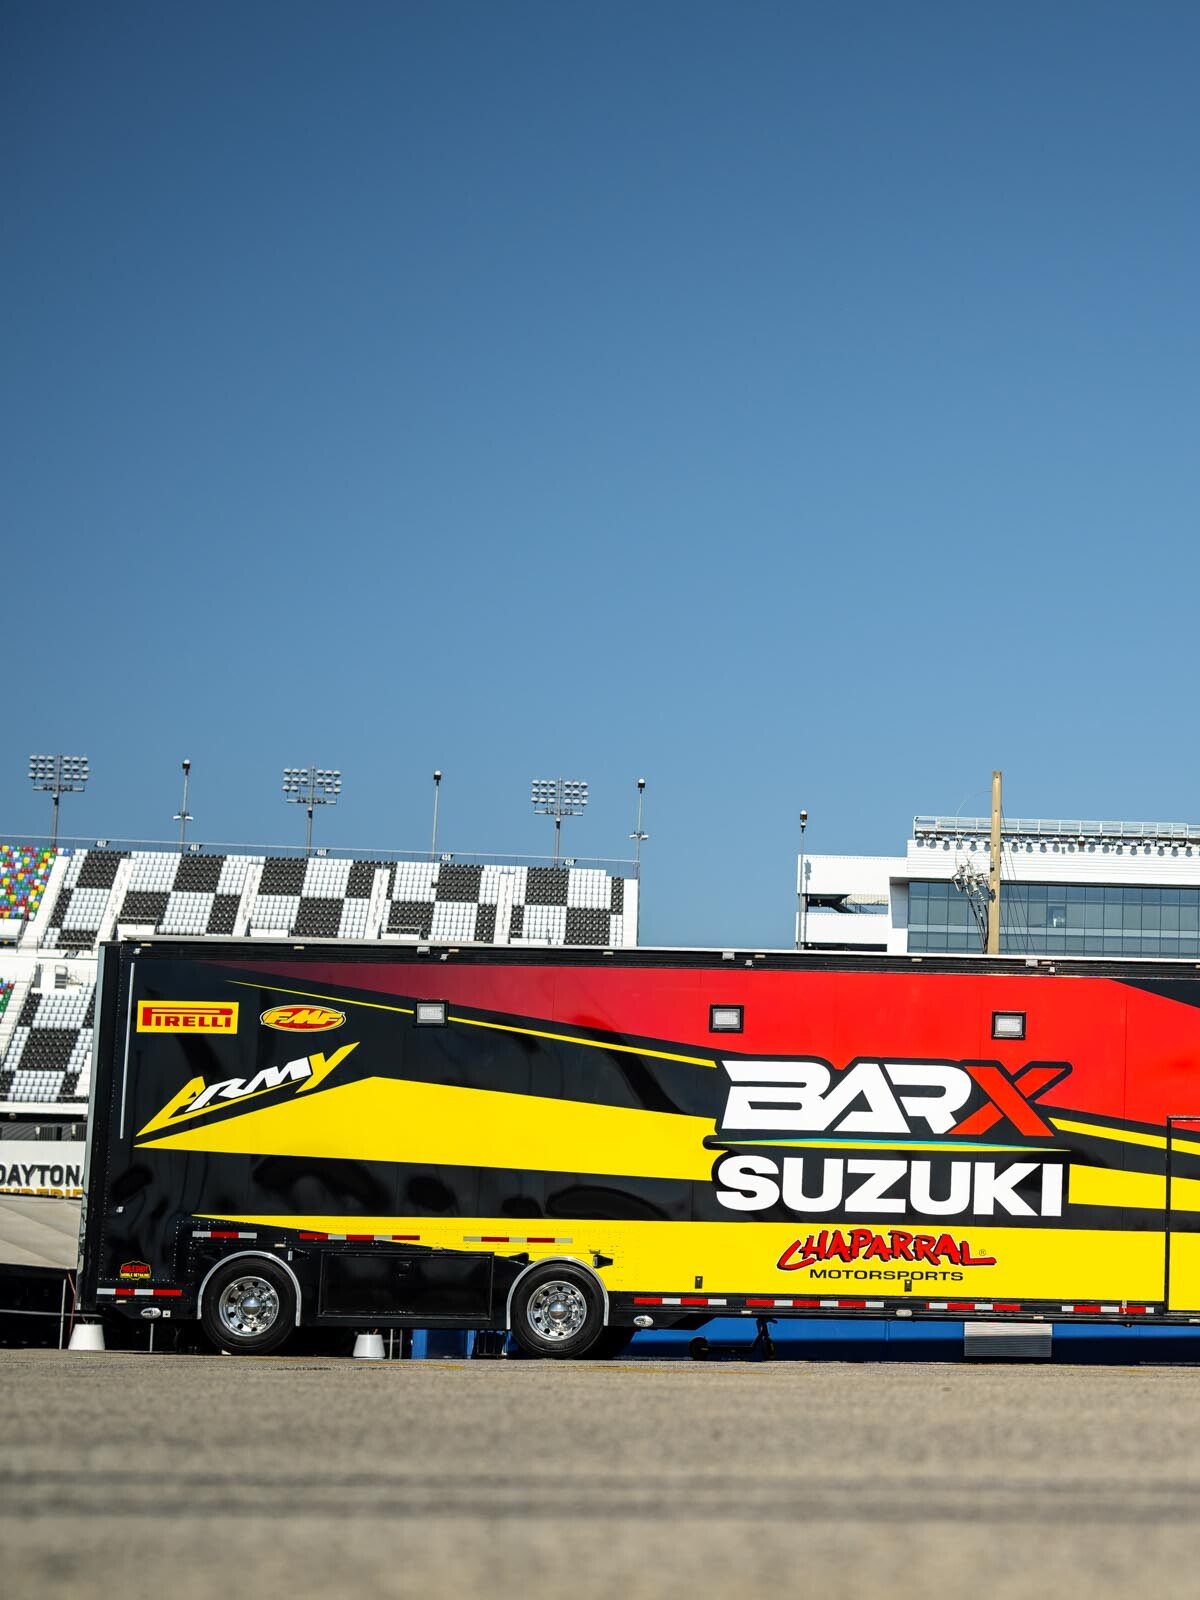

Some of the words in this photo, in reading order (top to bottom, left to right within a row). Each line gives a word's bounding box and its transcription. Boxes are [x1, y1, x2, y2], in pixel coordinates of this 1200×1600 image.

[142, 1006, 234, 1028] PIRELLI
[264, 1009, 343, 1025] FMF
[136, 1042, 360, 1137] ARMY
[721, 1060, 1066, 1137] BARX
[0, 1164, 84, 1187] DAYTON
[716, 1155, 1063, 1217] SUZUKI
[776, 1228, 997, 1270] CHAPARRAL
[809, 1268, 964, 1281] MOTORSPORTS
